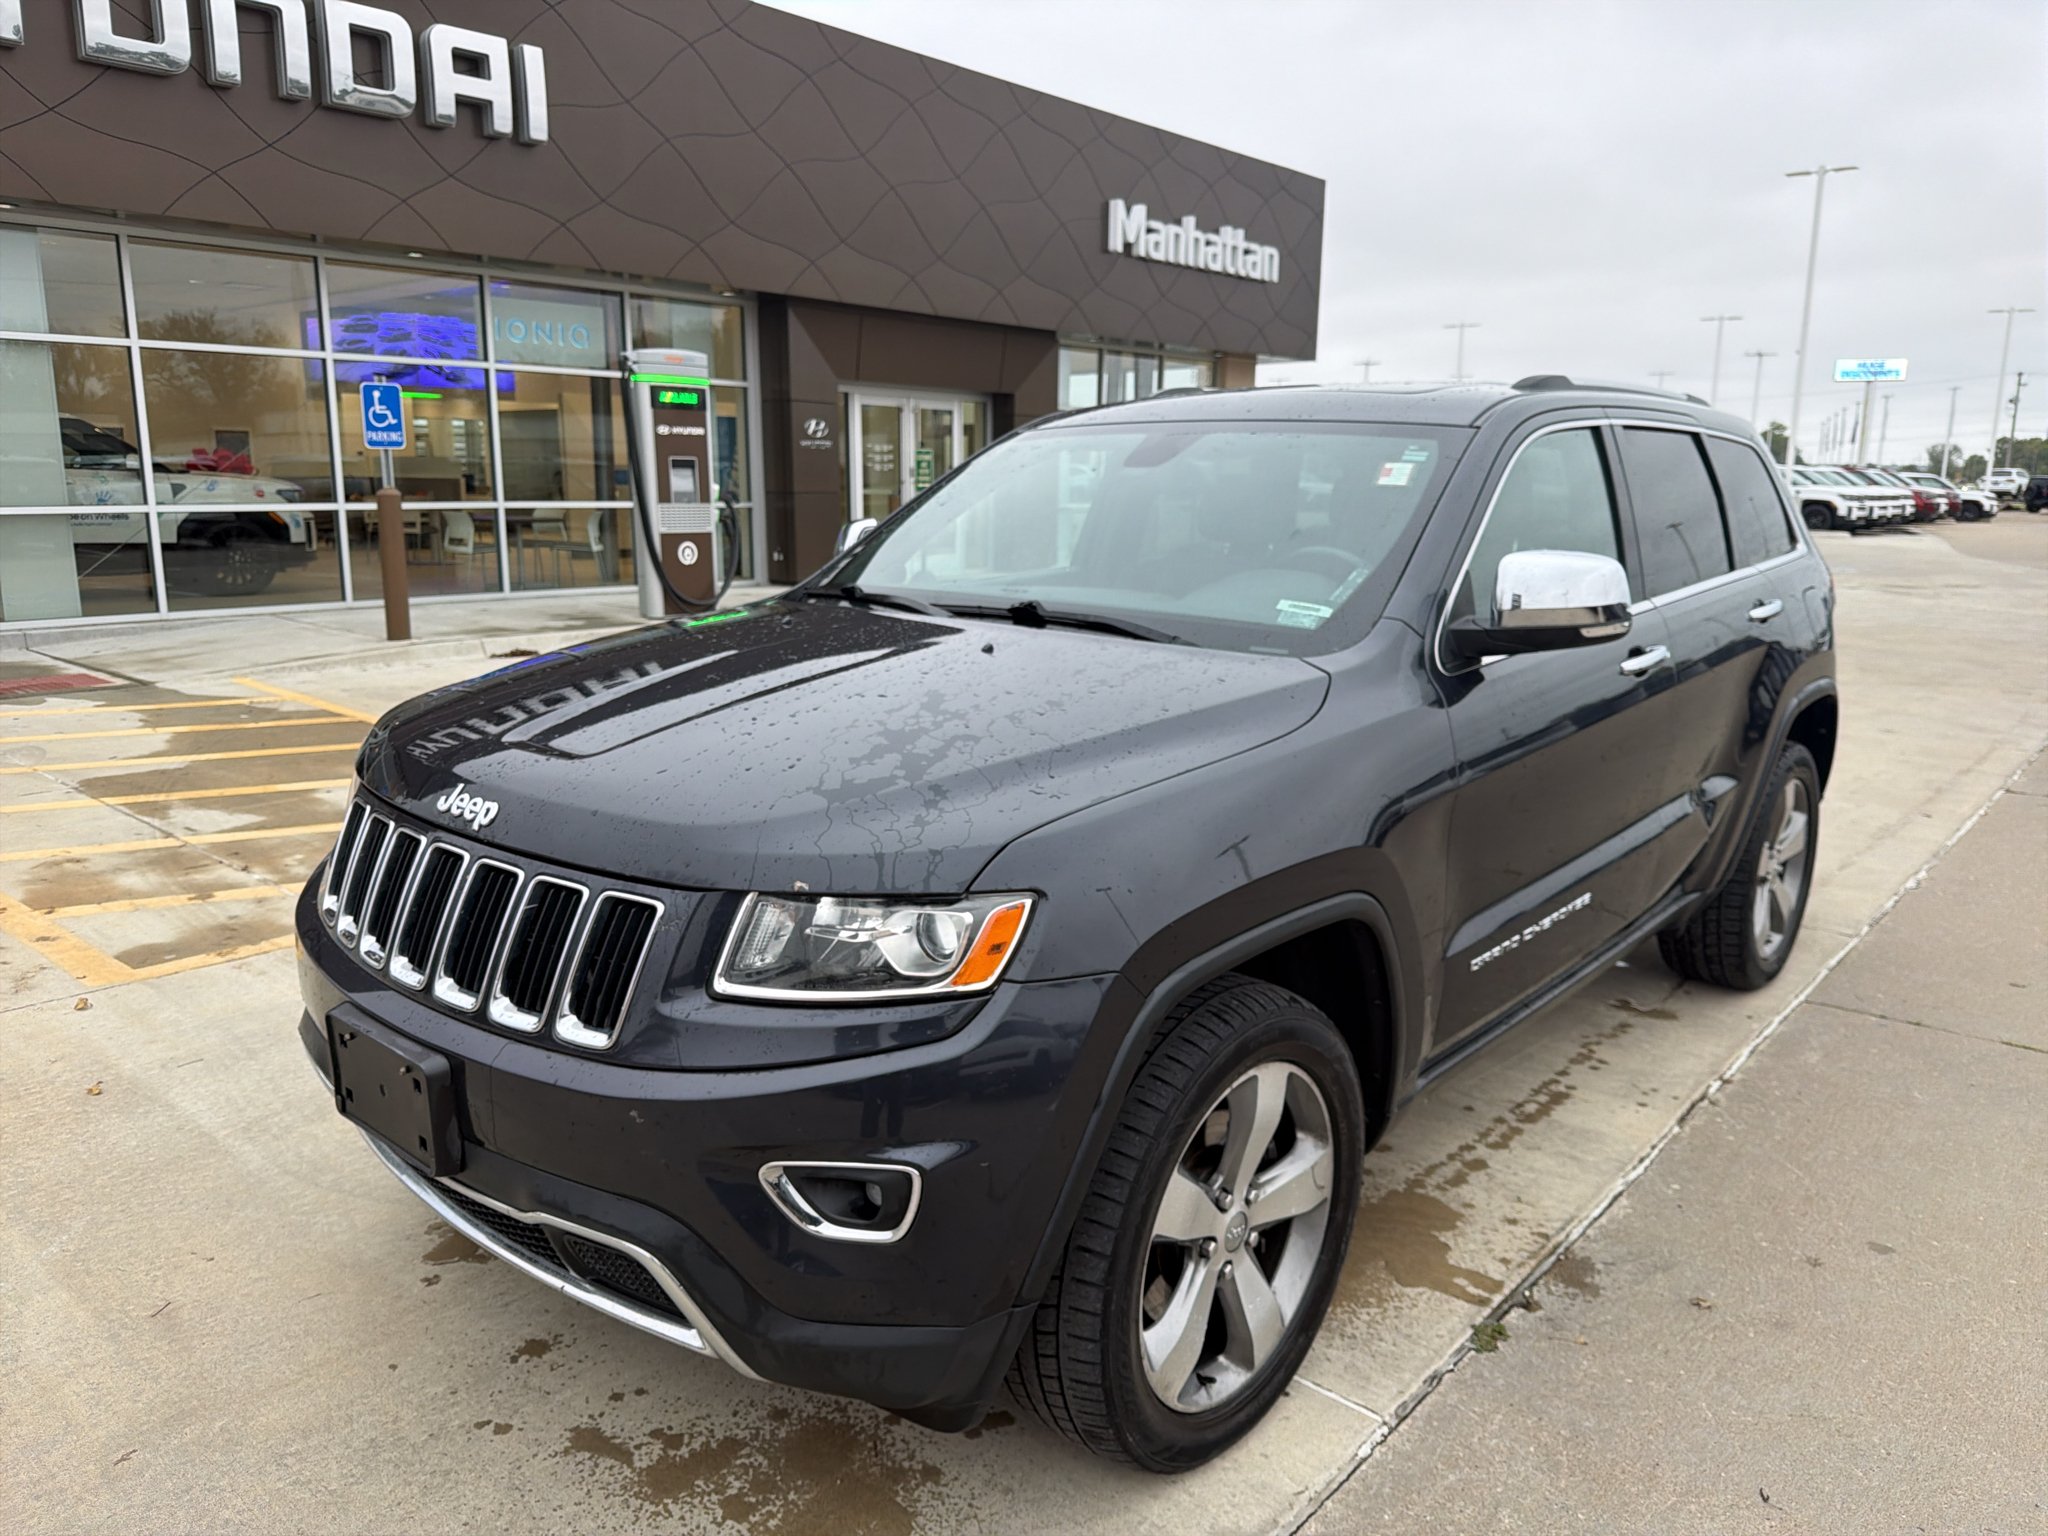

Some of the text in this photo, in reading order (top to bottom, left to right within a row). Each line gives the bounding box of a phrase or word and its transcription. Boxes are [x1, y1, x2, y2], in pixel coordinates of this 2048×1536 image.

[0, 0, 548, 145] UNDAI
[1108, 198, 1280, 283] Manhattan
[495, 316, 590, 349] IONIQ
[367, 430, 404, 443] PARKING
[436, 783, 499, 831] Jeep
